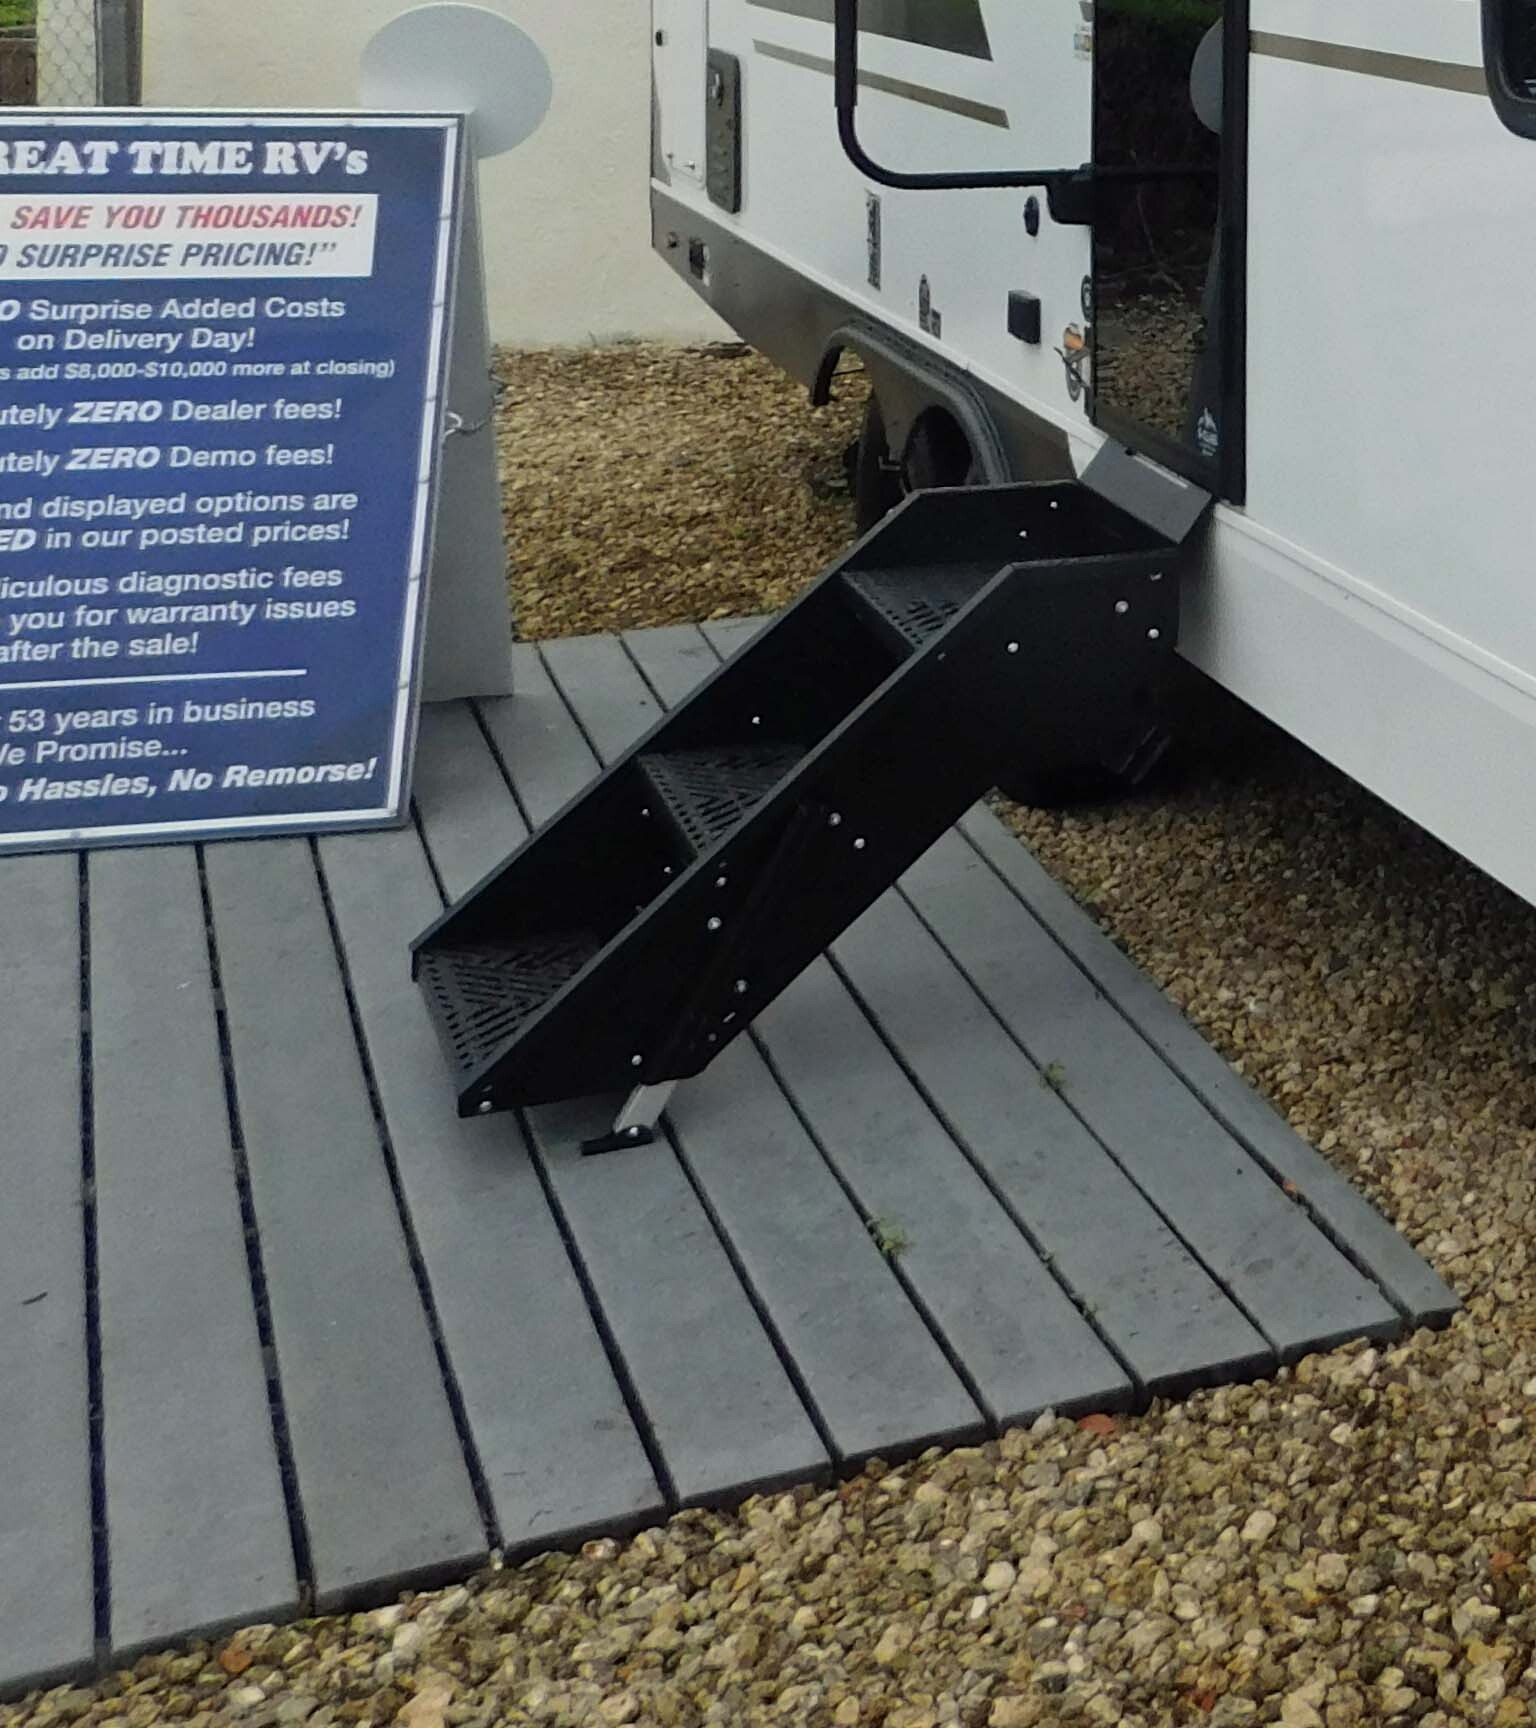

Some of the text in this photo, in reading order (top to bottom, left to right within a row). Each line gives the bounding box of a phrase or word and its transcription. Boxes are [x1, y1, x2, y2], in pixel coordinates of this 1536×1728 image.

[128, 140, 254, 175] TIME
[263, 140, 369, 175] RV's
[10, 203, 363, 230] SAVE YOU THOUSANDS!
[16, 242, 174, 269] SURPRISE
[29, 298, 153, 326] Surprise
[160, 296, 256, 320] Added
[264, 296, 347, 319] Costs
[16, 327, 256, 355] on Delivery Day!
[16, 364, 60, 381] add
[64, 360, 227, 381] $8,000-$10,000
[231, 363, 286, 376] more
[290, 362, 311, 376] at
[316, 359, 397, 379] closing)
[68, 399, 163, 424] ZERO
[170, 399, 268, 422] Dealer
[273, 397, 343, 420] fees!
[65, 445, 161, 471] ZERO
[169, 445, 257, 469] Demo
[264, 443, 335, 466] fees!
[41, 491, 187, 522] displayed
[195, 489, 305, 518] options
[312, 492, 359, 511] are
[45, 527, 72, 550] in
[81, 529, 134, 549] our
[138, 521, 245, 551] posted
[250, 517, 350, 548] prices!
[0, 565, 343, 600] iculous diagnostic fees
[9, 597, 357, 637] you for warranty issues
[71, 635, 119, 660] the
[128, 631, 200, 657] sale!
[8, 697, 316, 736] 53 years in business
[35, 735, 189, 765] Promise...
[17, 772, 158, 803] Hassles,
[167, 766, 213, 793] No
[221, 756, 379, 790] Remorse!
